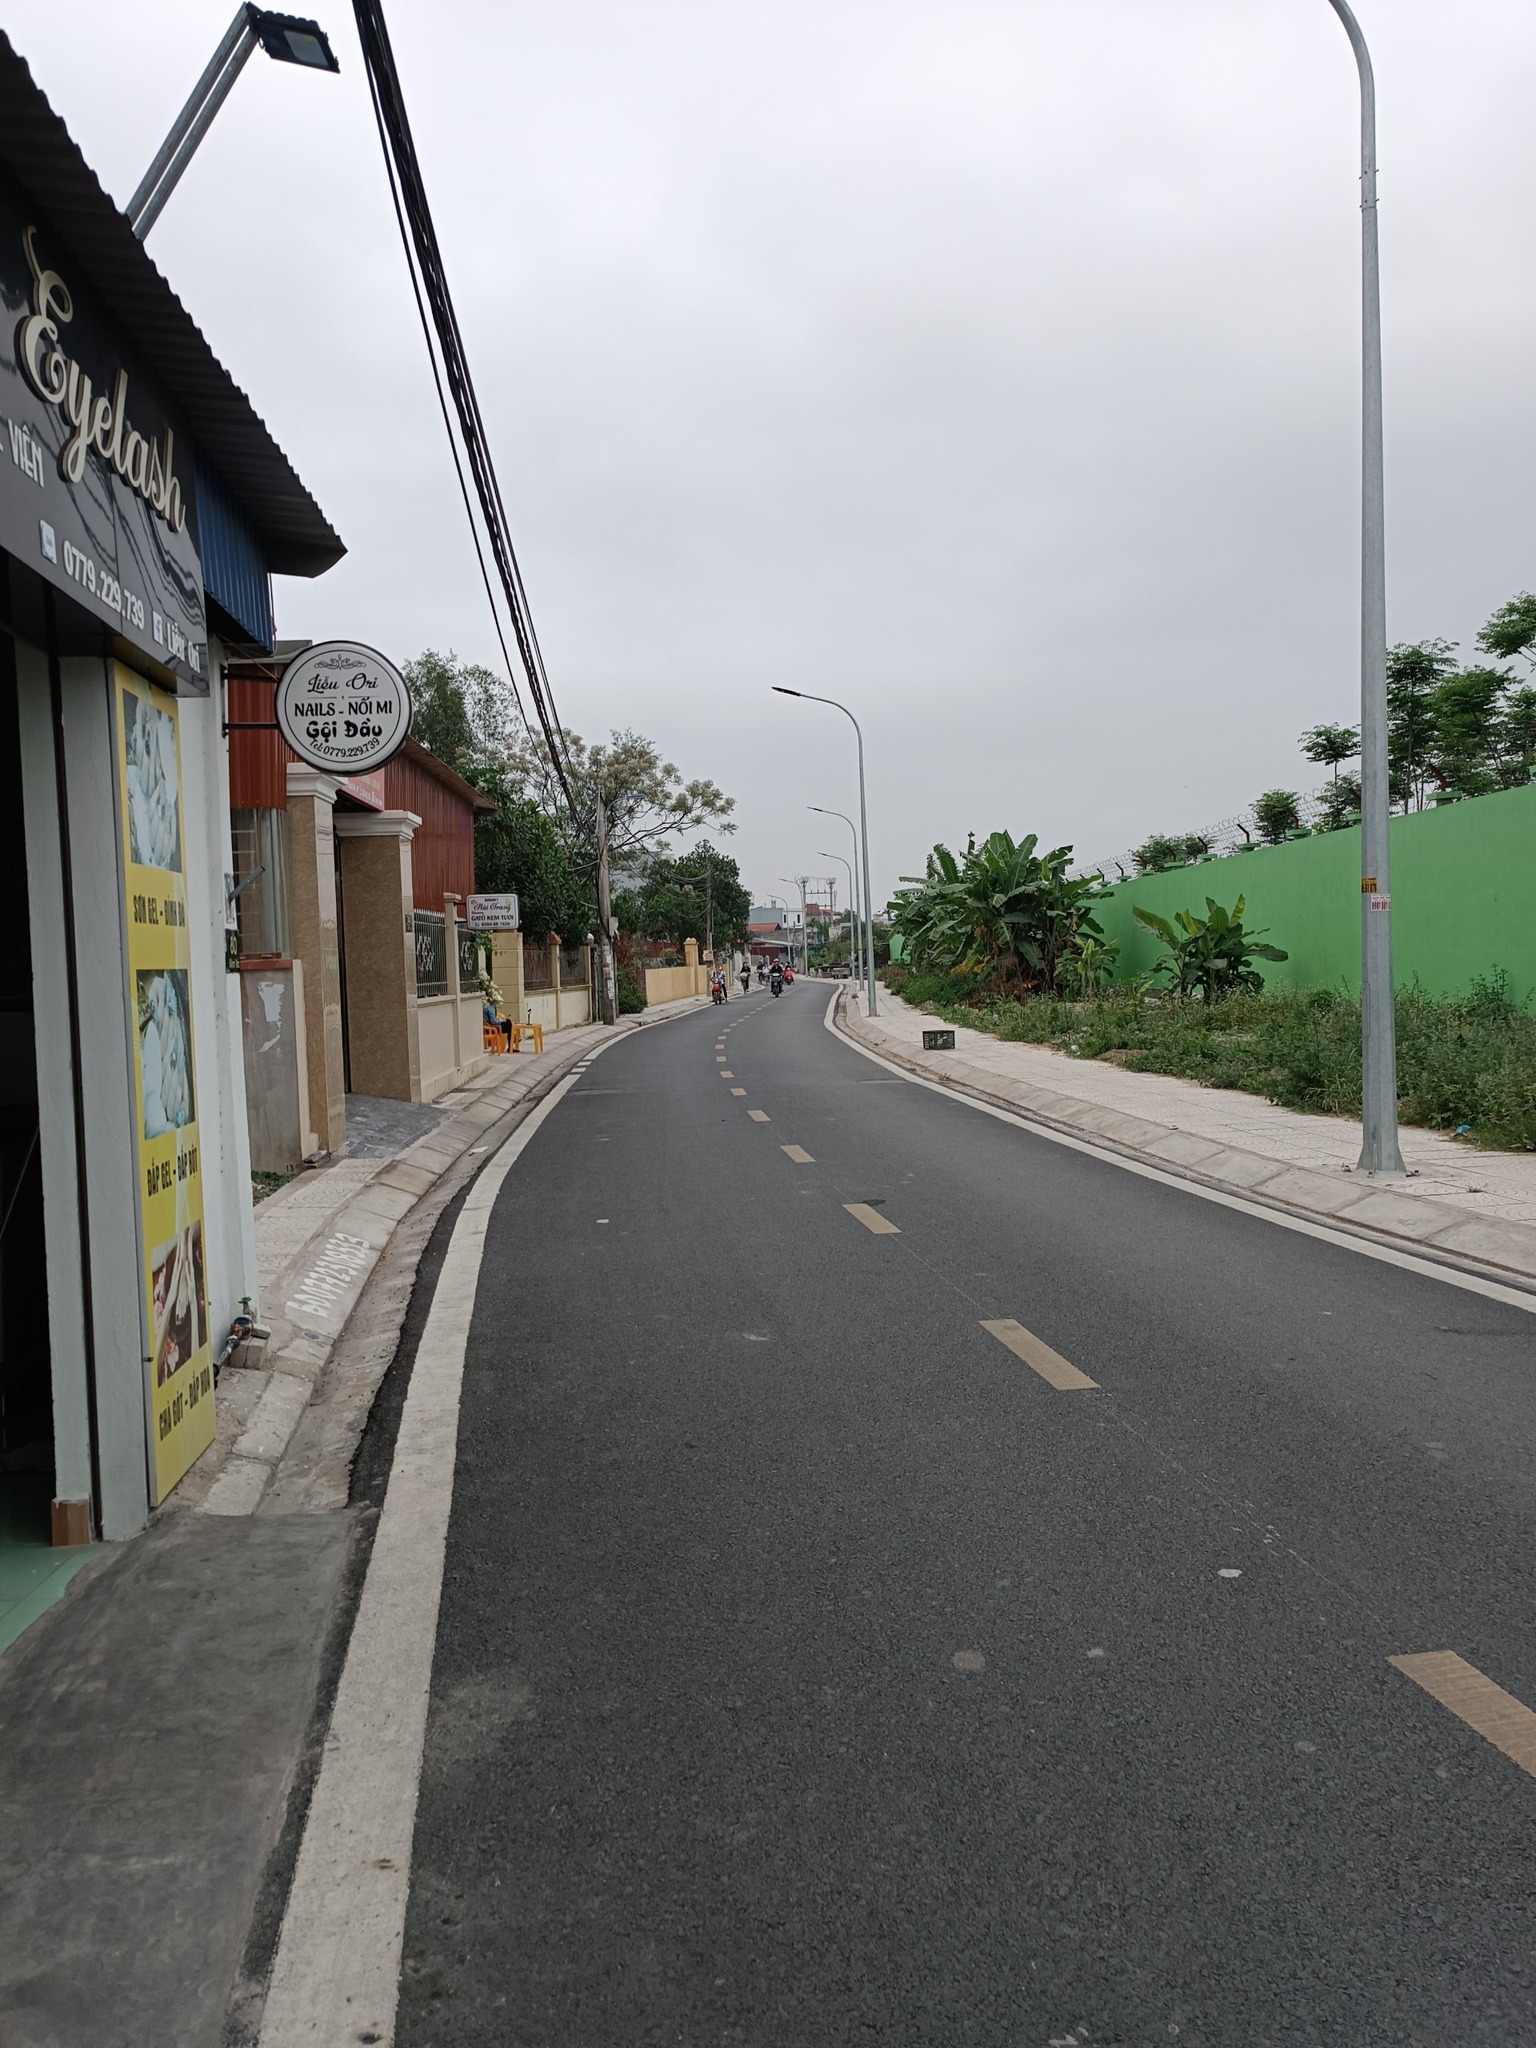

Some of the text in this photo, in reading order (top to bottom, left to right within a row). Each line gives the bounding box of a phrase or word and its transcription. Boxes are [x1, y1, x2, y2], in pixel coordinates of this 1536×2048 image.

[17, 225, 186, 533] Eyelash
[8, 418, 44, 488] VIÊN
[63, 540, 144, 630] 0779.229.739
[307, 673, 379, 694] Liễu Ori
[294, 702, 336, 717] NAILS
[348, 696, 372, 715] NỐI
[377, 700, 392, 714] MI
[306, 720, 337, 743] Gội
[147, 896, 159, 925] GEL
[161, 1159, 172, 1190] GEL
